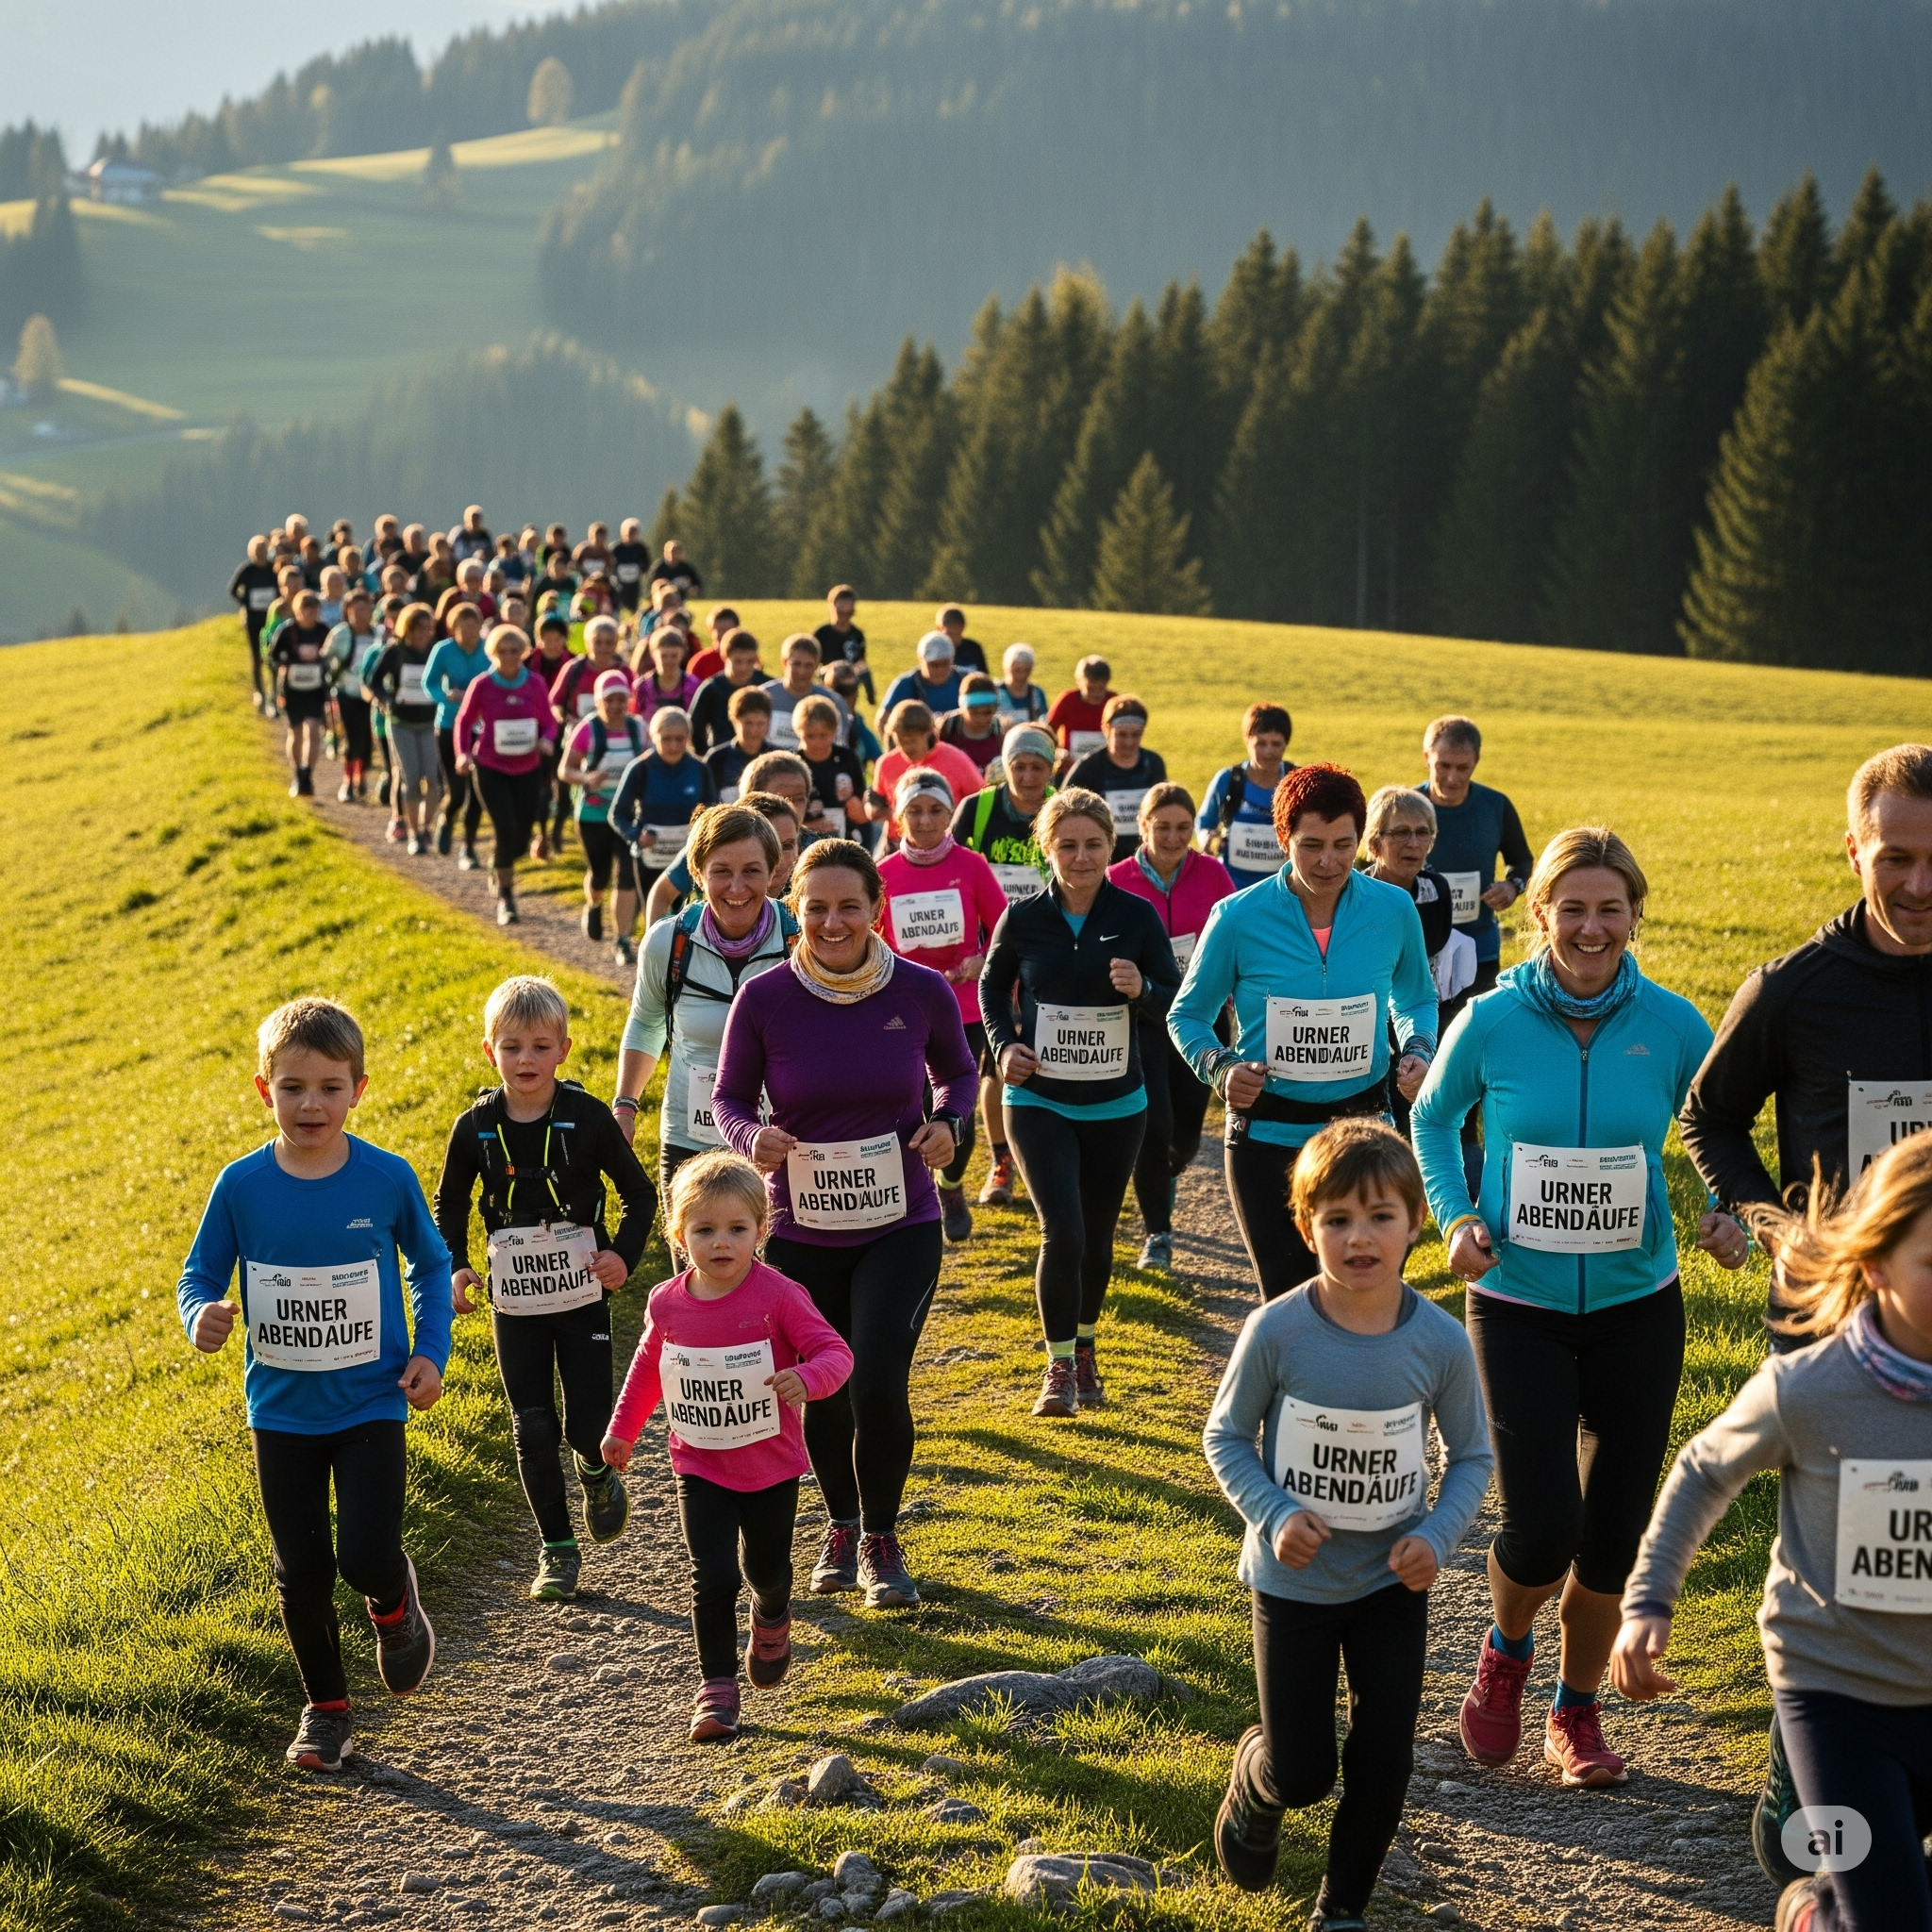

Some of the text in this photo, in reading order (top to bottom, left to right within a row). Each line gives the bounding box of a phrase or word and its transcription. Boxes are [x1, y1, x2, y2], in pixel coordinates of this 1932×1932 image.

[909, 908, 945, 924] URNER
[1058, 1028, 1106, 1046] URNER
[1292, 1025, 1350, 1044] URNER
[813, 1168, 876, 1190] URNER
[1541, 1179, 1612, 1205] URNER
[1516, 1204, 1640, 1231] ABENDÄUFE
[512, 1250, 571, 1274] URNER
[276, 1298, 347, 1323] URNER
[680, 1377, 744, 1403] URNER
[1313, 1442, 1397, 1475] URNER
